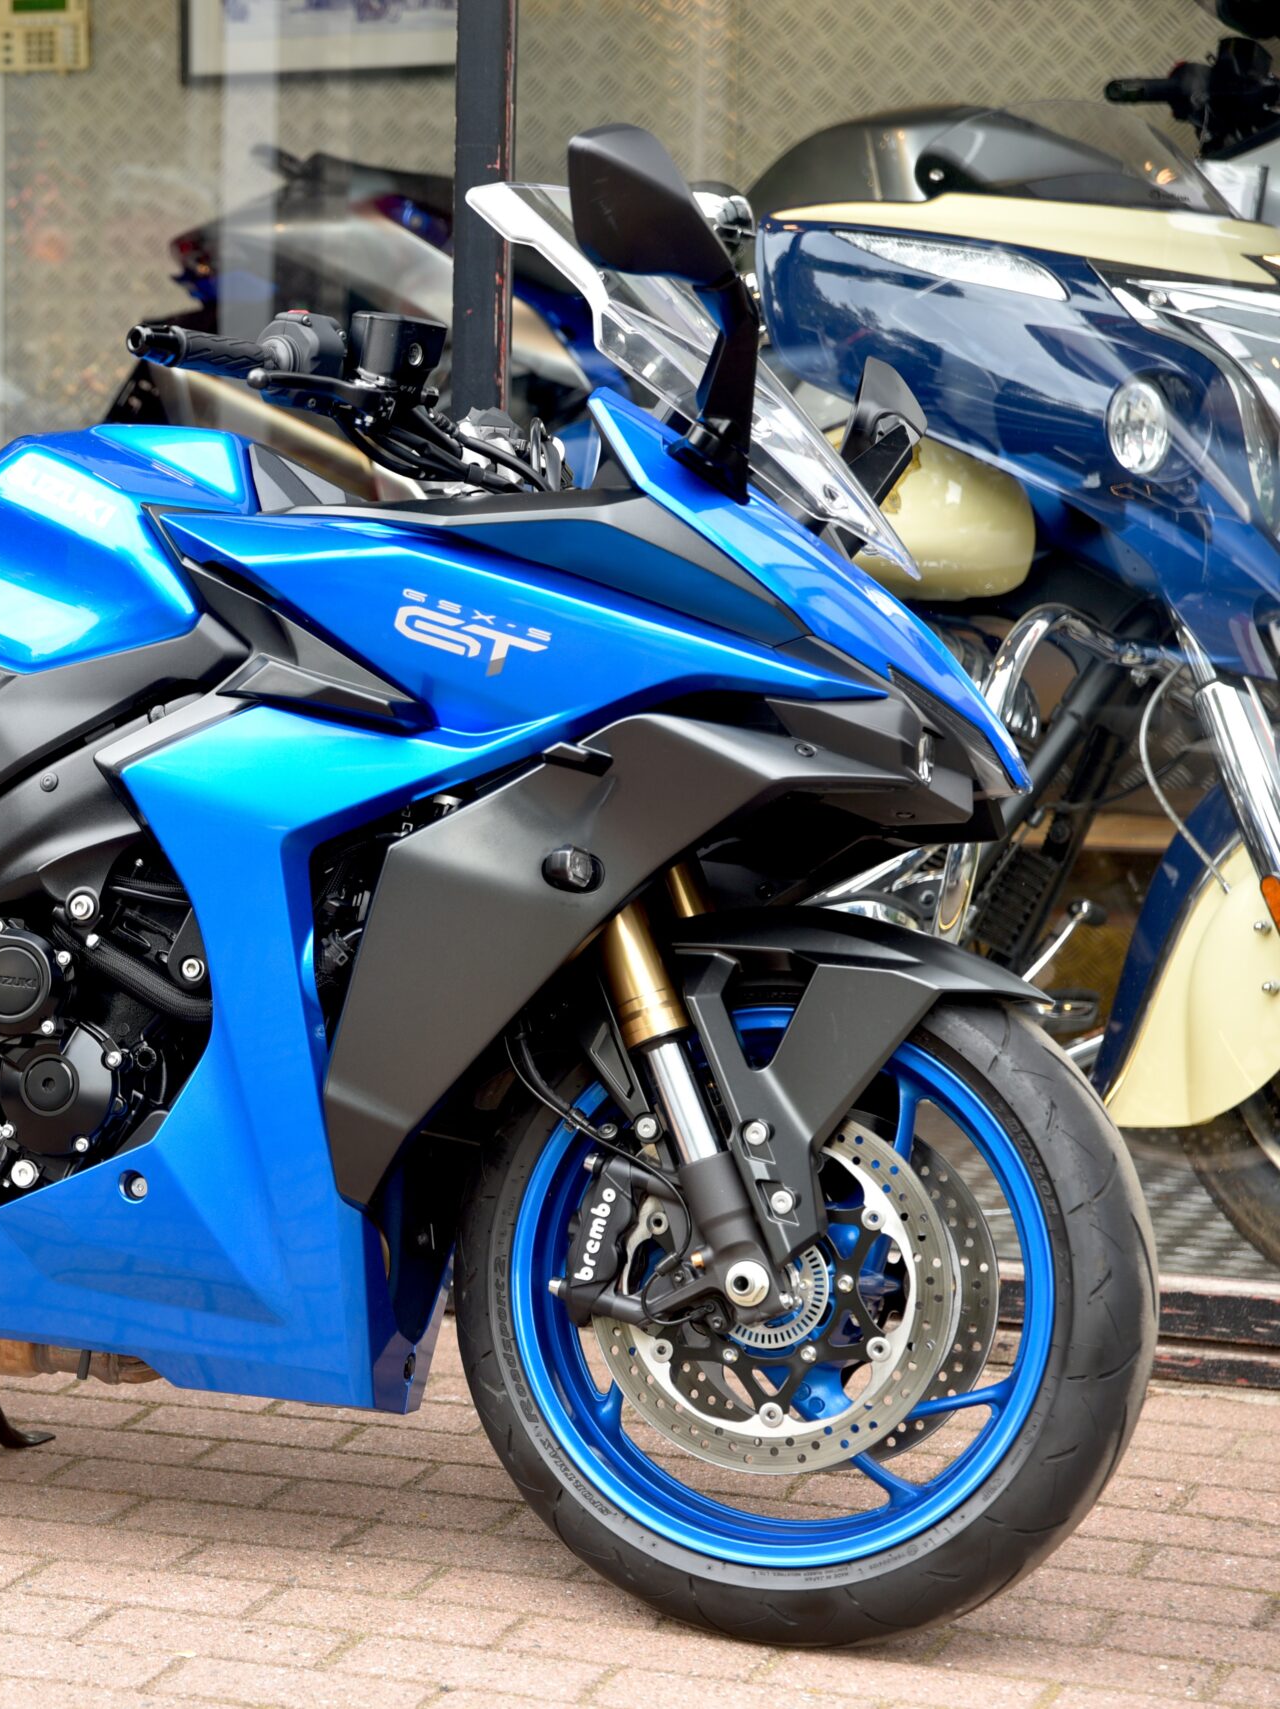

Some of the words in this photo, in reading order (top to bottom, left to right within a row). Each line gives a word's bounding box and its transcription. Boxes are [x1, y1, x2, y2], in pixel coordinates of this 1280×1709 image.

[394, 605, 549, 677] GT
[402, 588, 552, 642] GSX-S
[1006, 1120, 1059, 1216] DUNLOP
[574, 1188, 616, 1281] brembo
[494, 1279, 539, 1423] Roadsport
[540, 1438, 612, 1518] SPORTMAX
